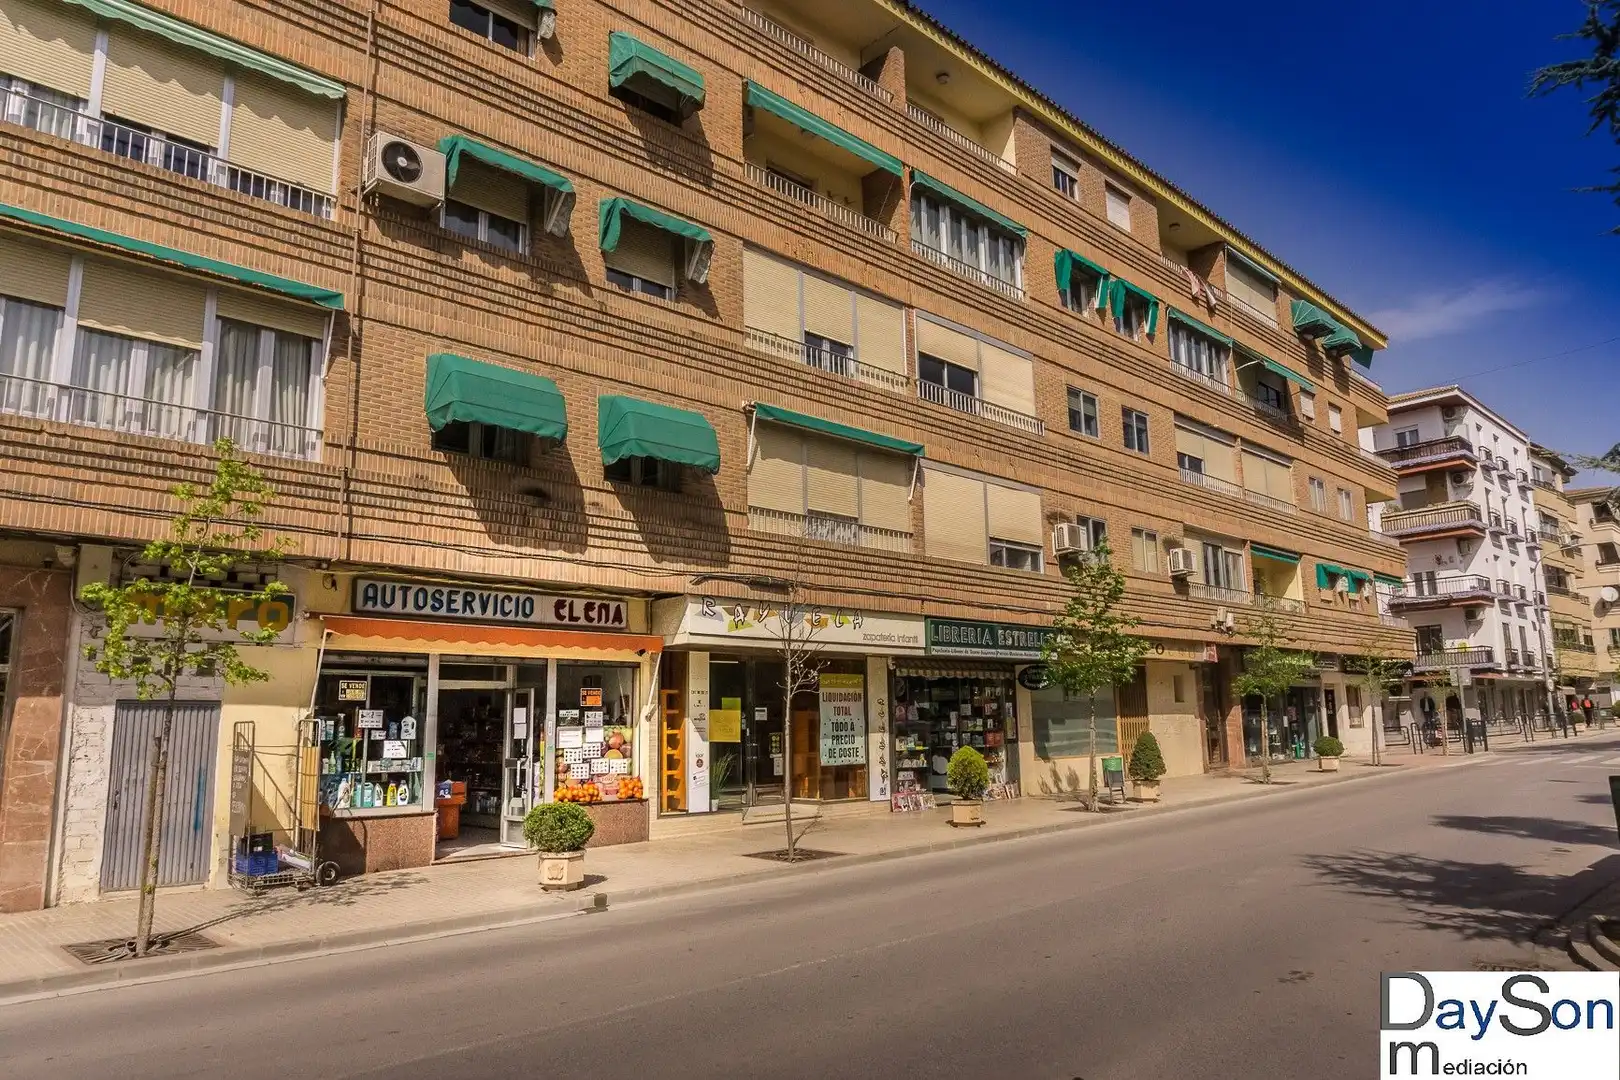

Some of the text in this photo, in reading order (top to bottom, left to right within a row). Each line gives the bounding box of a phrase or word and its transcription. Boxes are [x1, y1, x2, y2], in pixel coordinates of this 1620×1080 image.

[362, 582, 535, 618] AUTOSERVICIO
[701, 597, 864, 630] RAYUELA
[832, 706, 852, 717] TOTAL
[831, 721, 856, 733] TODO A
[831, 735, 856, 746] PRECIO
[828, 747, 860, 759] DE COSTE
